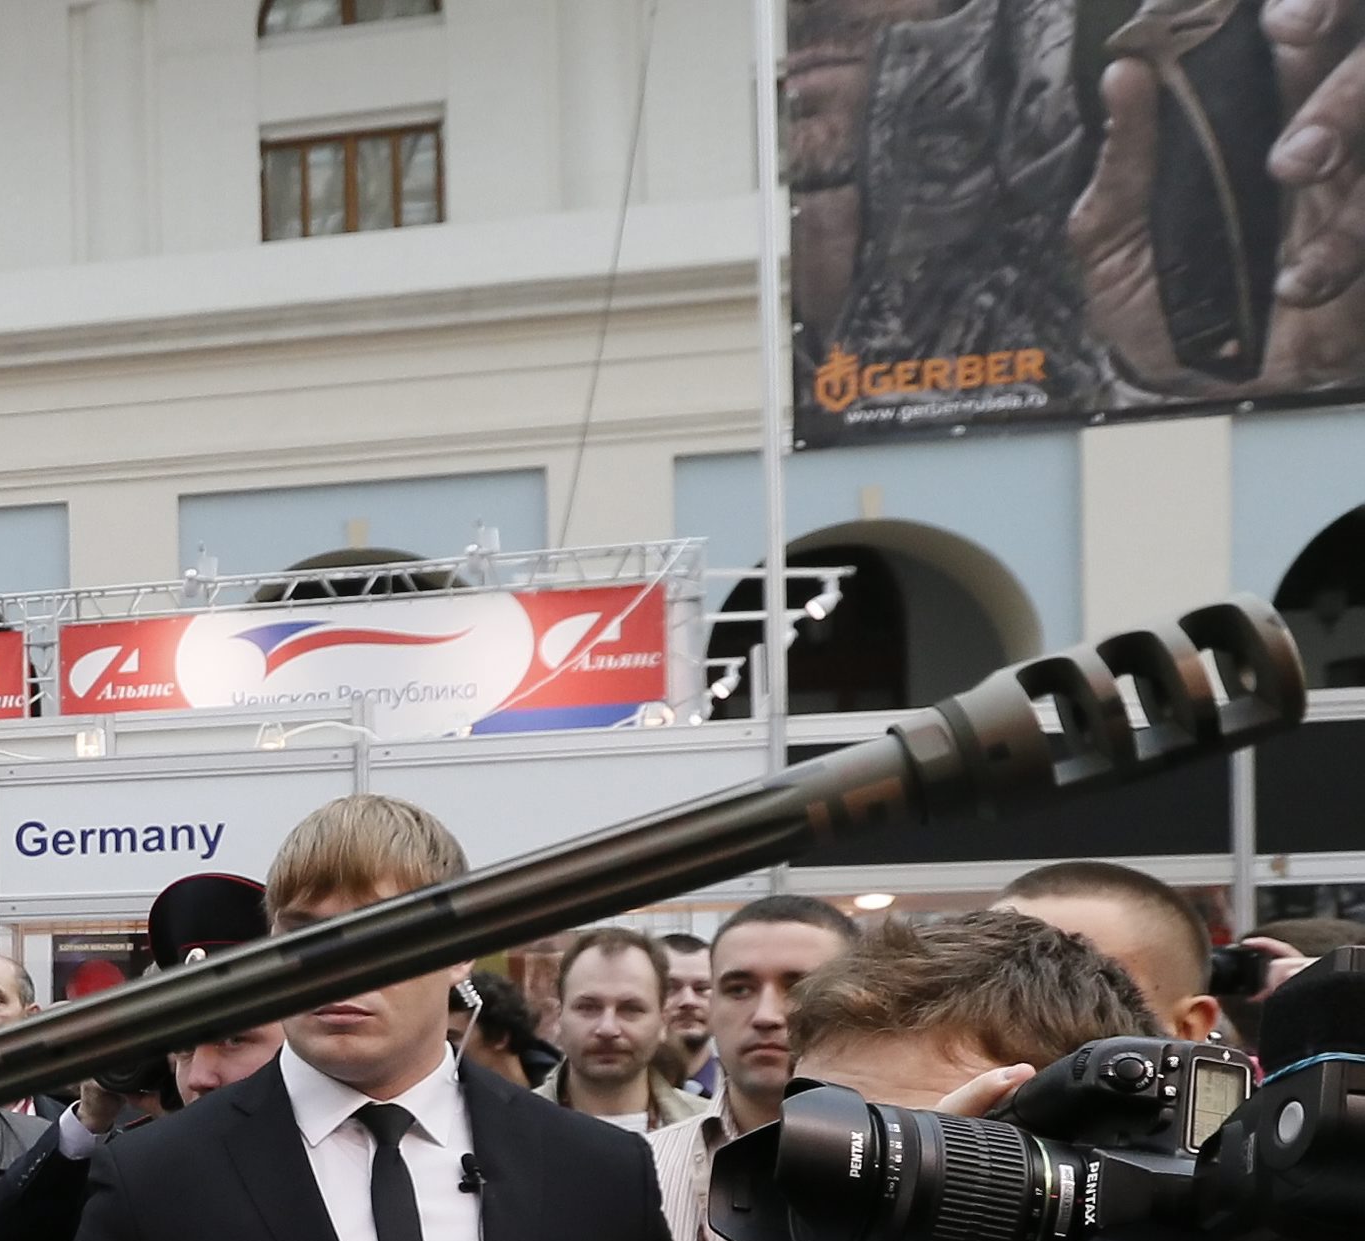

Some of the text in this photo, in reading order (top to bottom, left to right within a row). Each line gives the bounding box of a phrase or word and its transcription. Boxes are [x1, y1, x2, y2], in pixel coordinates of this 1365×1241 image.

[862, 348, 1047, 396] GERBER
[97, 679, 174, 701] Альянс
[15, 820, 226, 861] Germany
[850, 1131, 864, 1178] PENTAX
[1084, 1160, 1101, 1226] PENTAX
